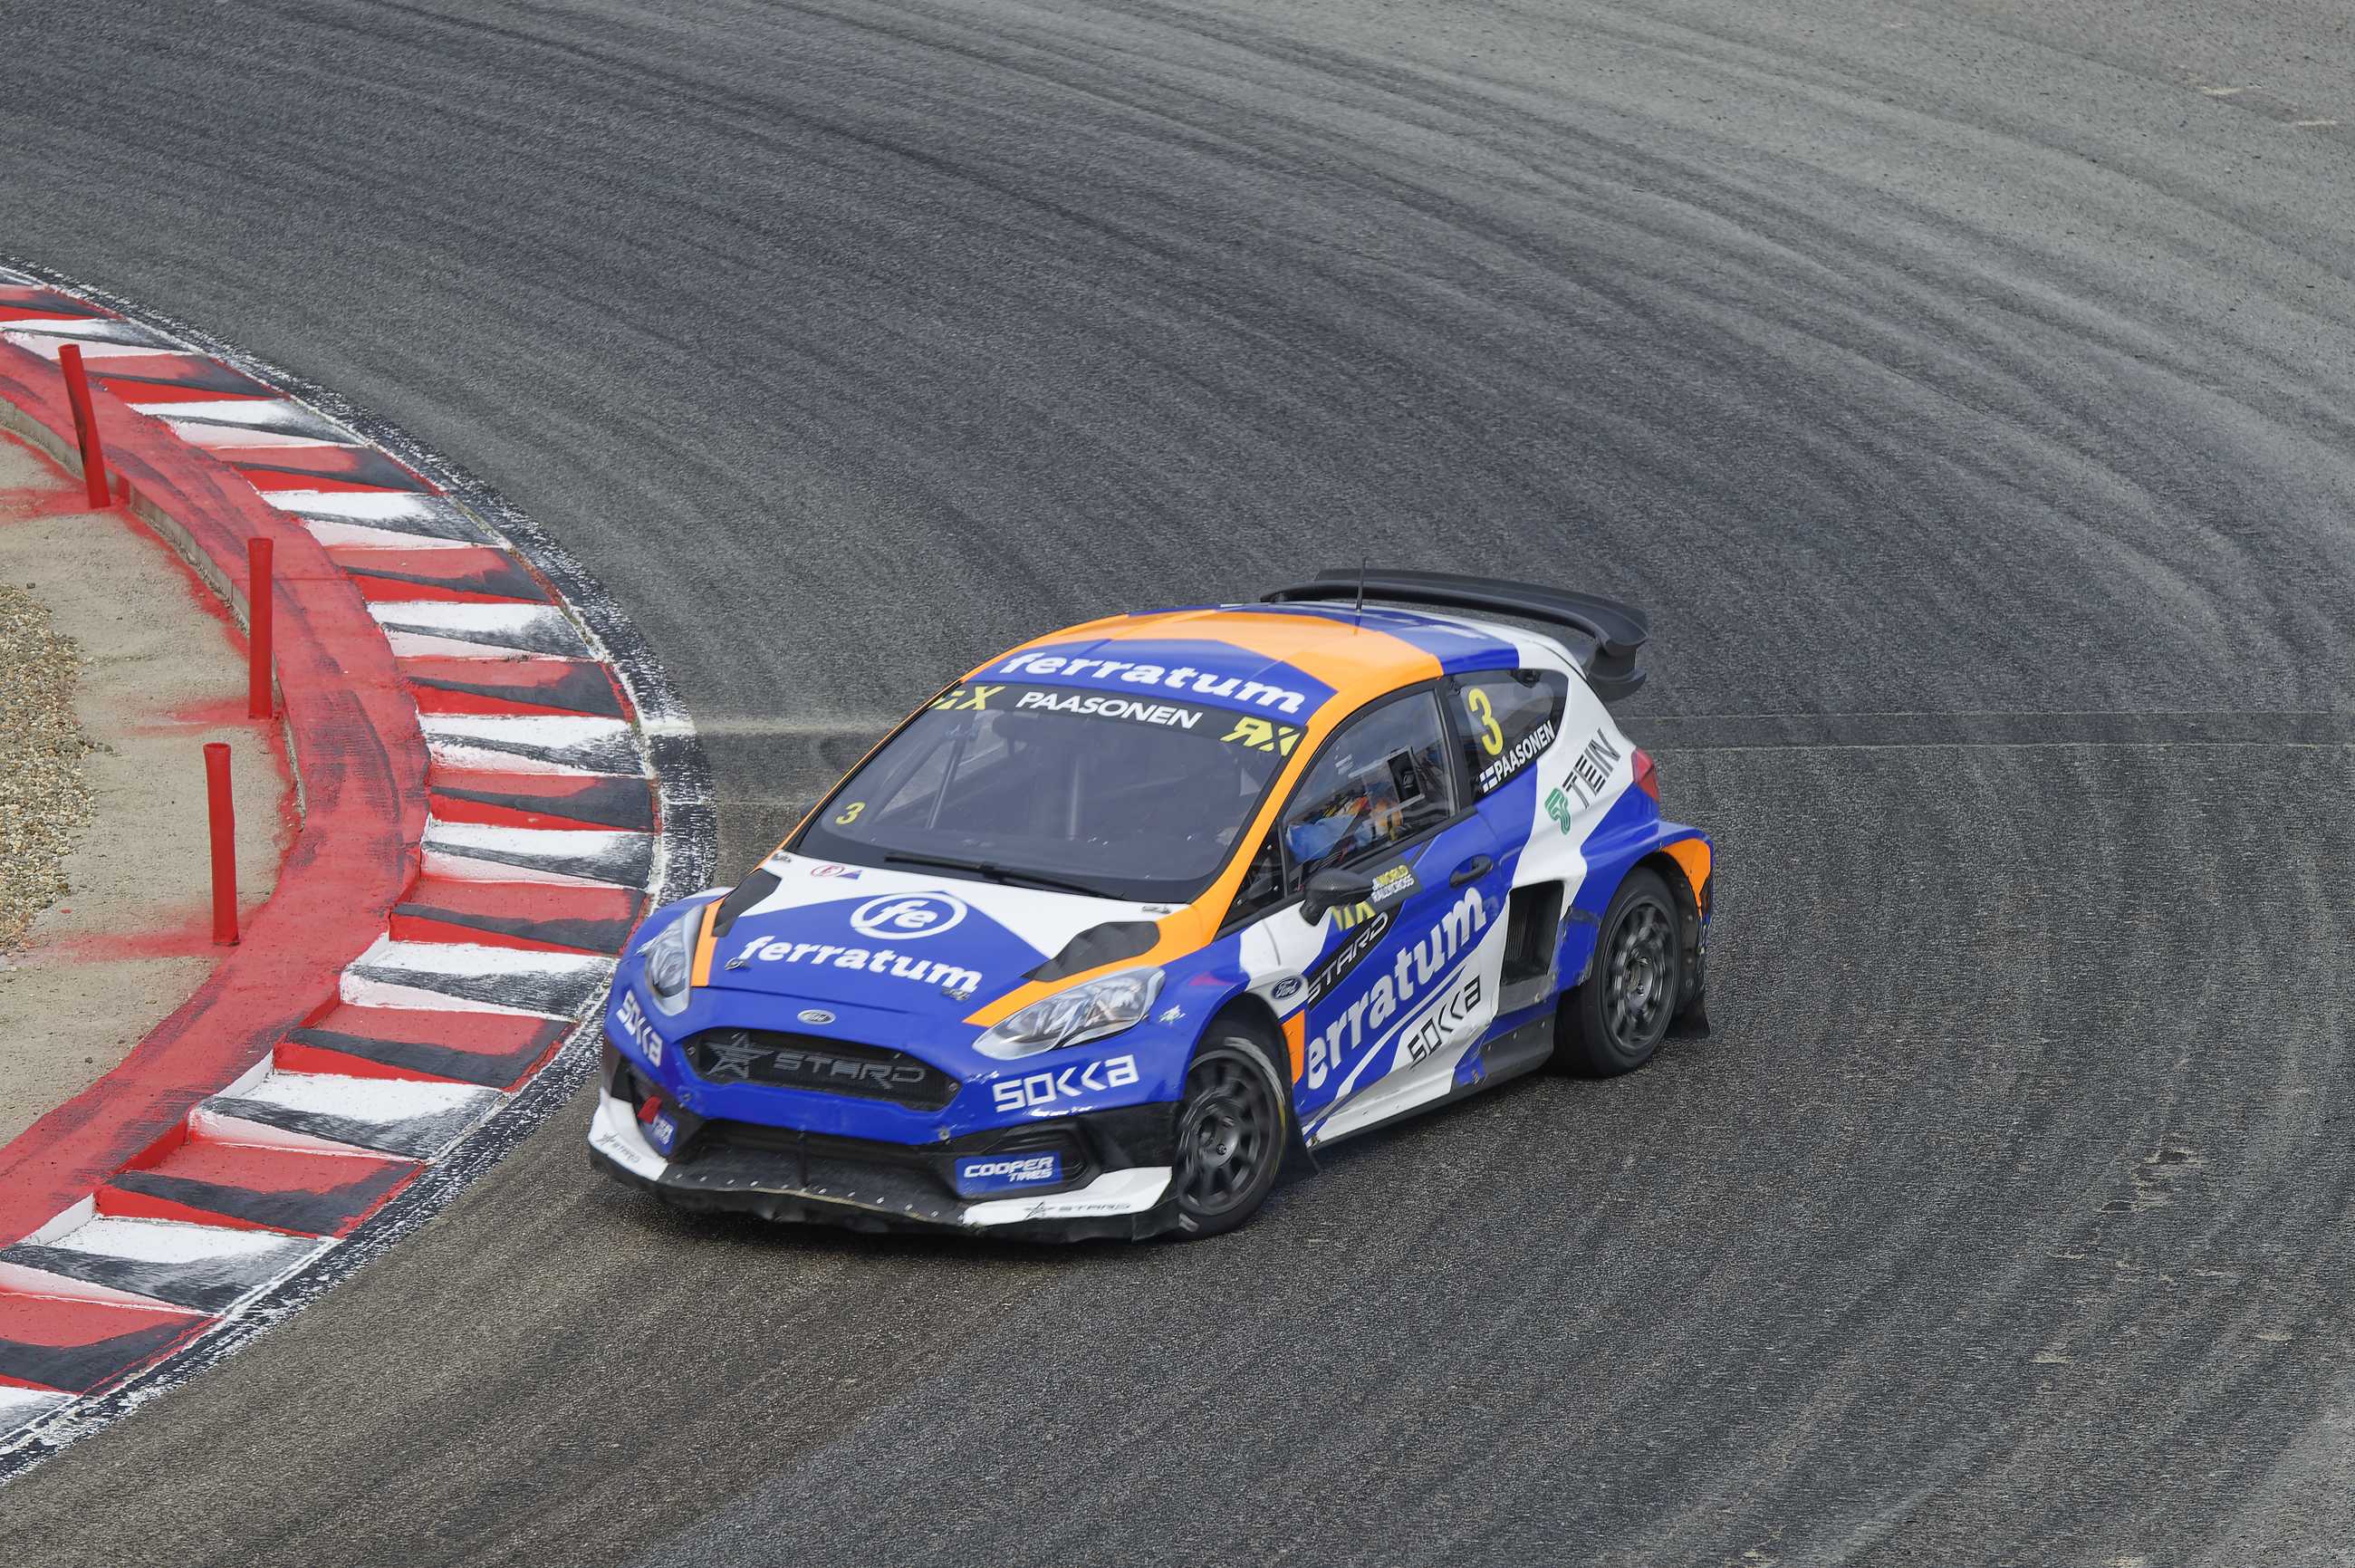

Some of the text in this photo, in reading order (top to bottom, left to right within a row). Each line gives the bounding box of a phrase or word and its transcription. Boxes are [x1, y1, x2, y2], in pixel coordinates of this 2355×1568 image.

[999, 652, 1305, 714] ferratum
[1016, 691, 1202, 729] PAASONEN
[1468, 688, 1504, 755] 3
[1495, 720, 1555, 782] PAASONEN
[1562, 727, 1621, 809] TEIN
[835, 802, 866, 825] 3
[738, 936, 984, 994] ferratum
[1308, 911, 1389, 1005] STARD
[773, 1052, 927, 1089] STARD
[964, 1157, 1055, 1178] COOPER
[1008, 1168, 1054, 1182] TIRES
